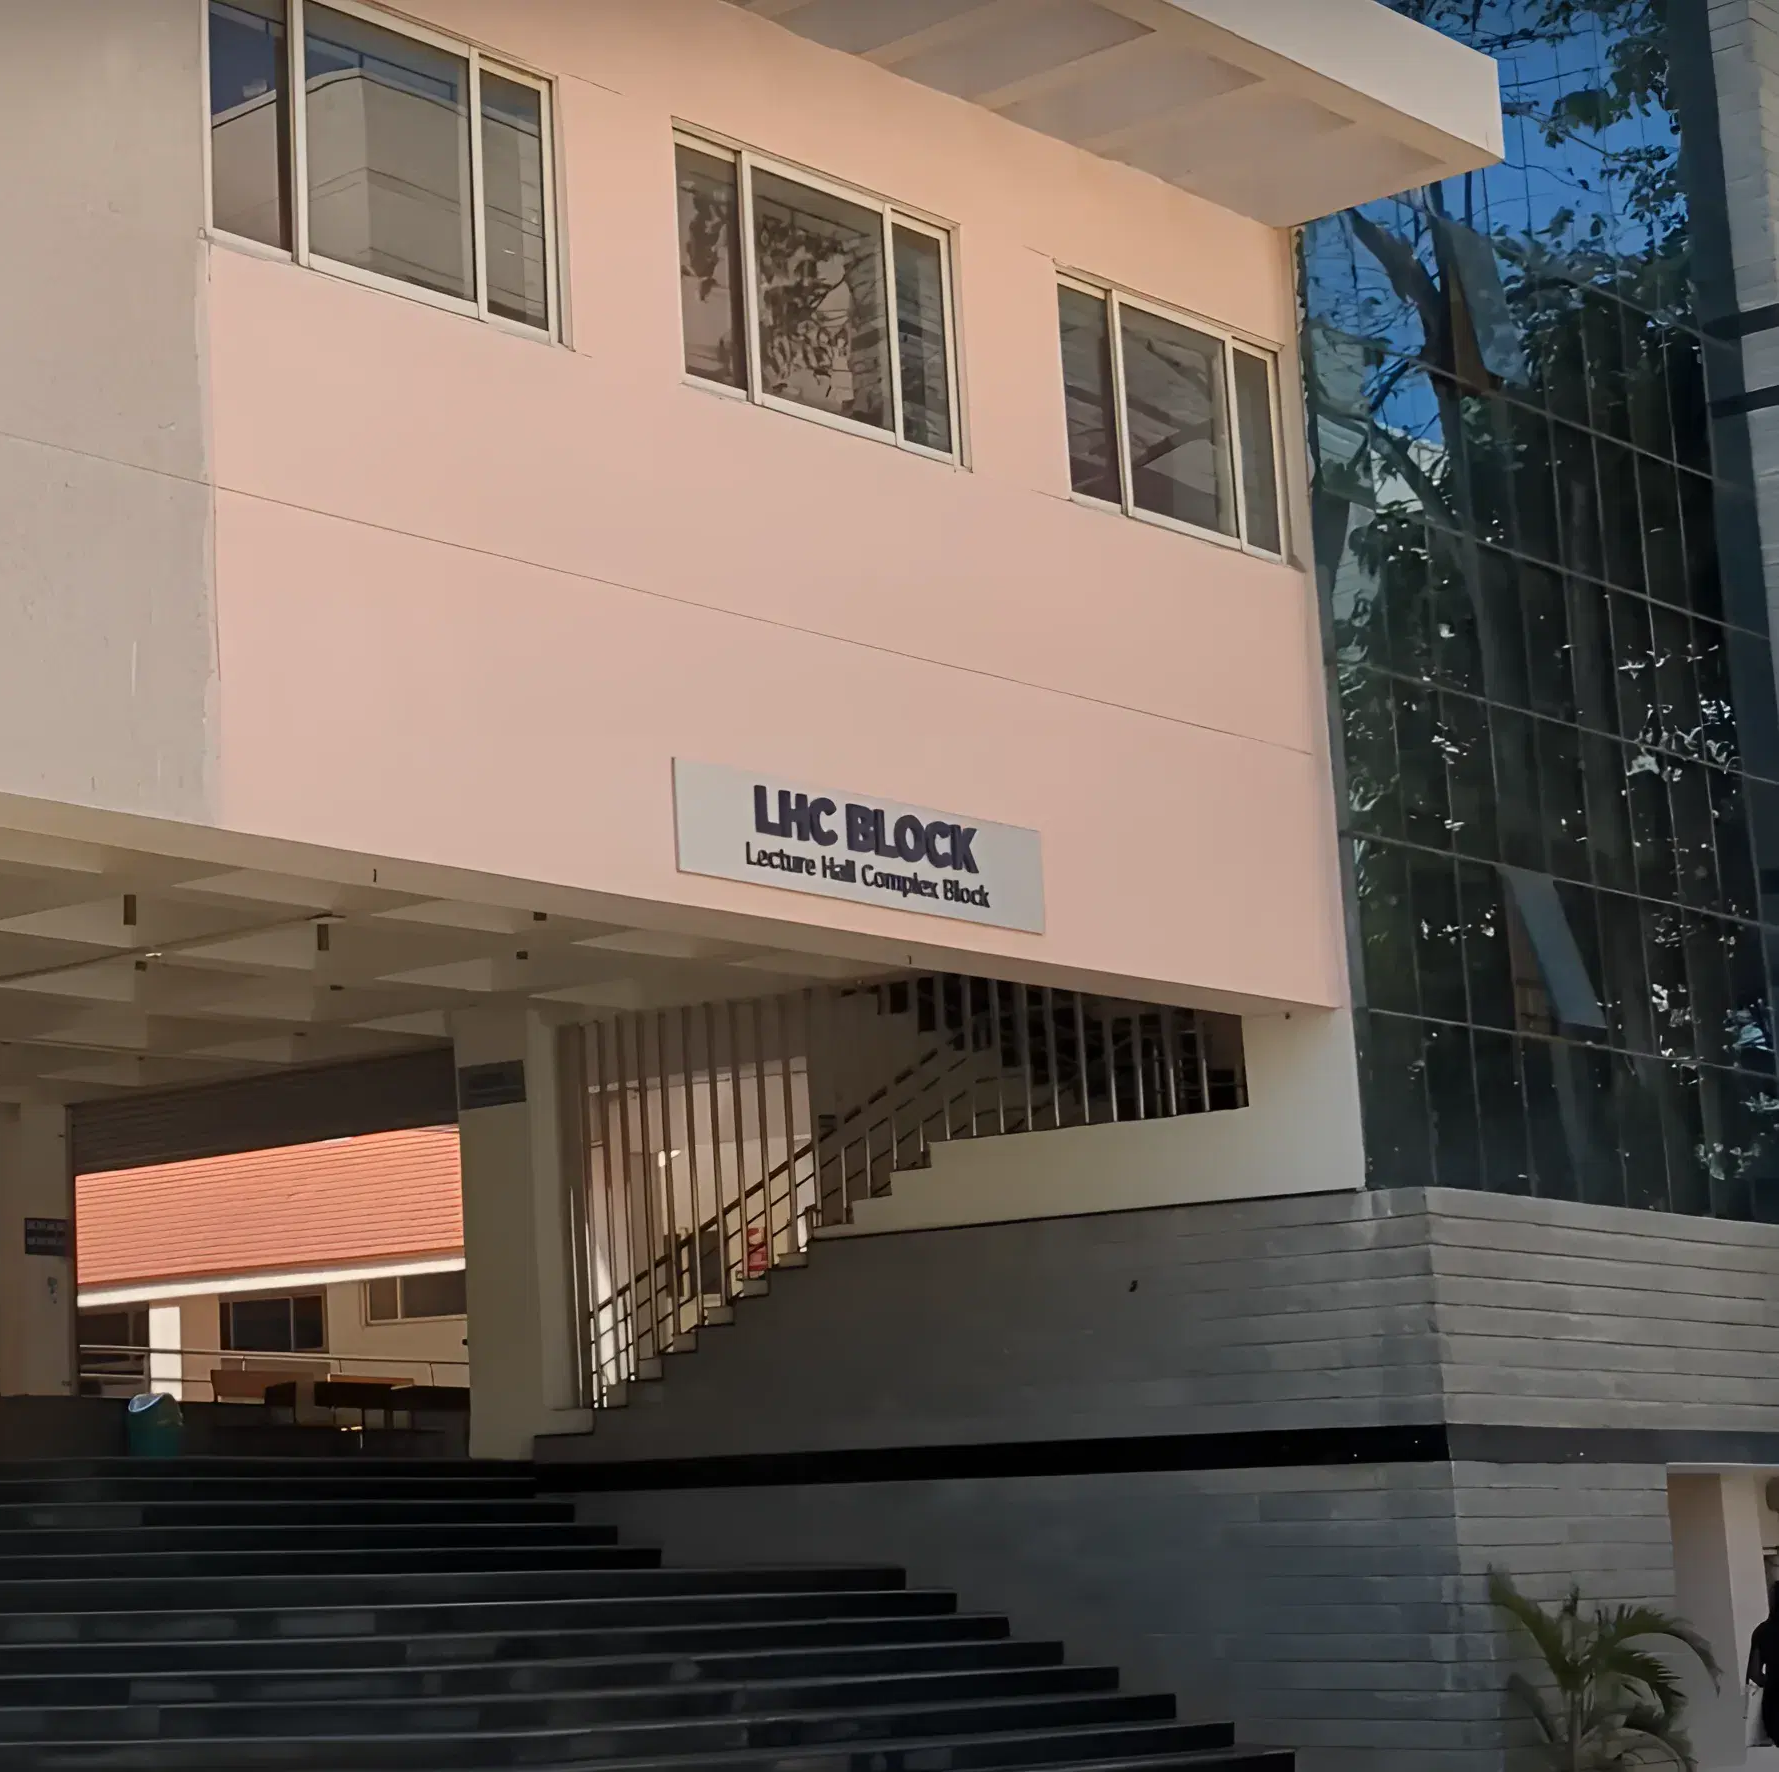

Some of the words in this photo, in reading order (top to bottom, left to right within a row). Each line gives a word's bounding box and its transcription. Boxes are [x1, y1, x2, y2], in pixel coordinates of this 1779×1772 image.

[754, 785, 838, 846] LHC
[845, 803, 979, 873] BLOCK
[746, 841, 816, 876] Lecture
[821, 855, 856, 883] Hall
[862, 864, 939, 899] Complex
[943, 879, 990, 908] Block
